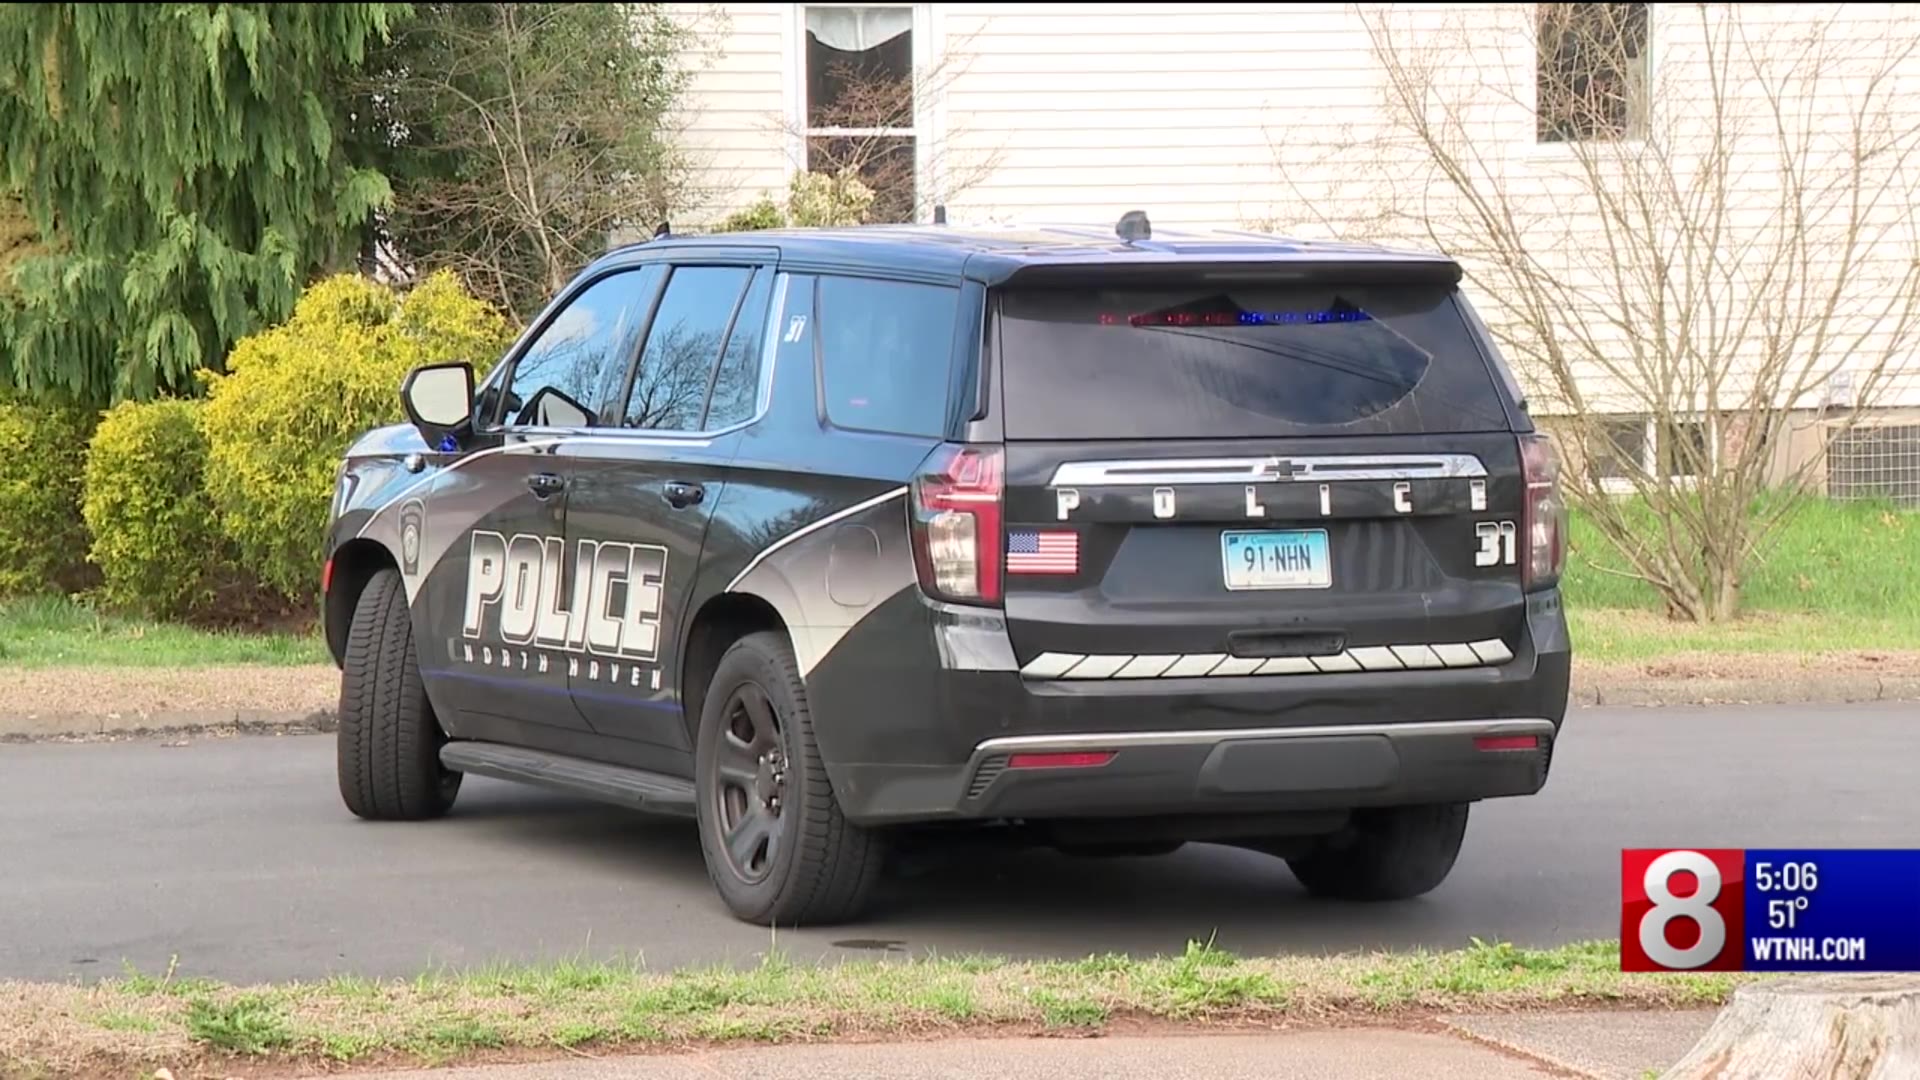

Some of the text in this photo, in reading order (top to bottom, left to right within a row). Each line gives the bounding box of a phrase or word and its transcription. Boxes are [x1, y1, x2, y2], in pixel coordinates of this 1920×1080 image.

[1057, 480, 1487, 520] POLICE
[1474, 520, 1517, 567] 31
[463, 530, 668, 662] POLICE
[463, 644, 662, 690] NORTH HAVEN
